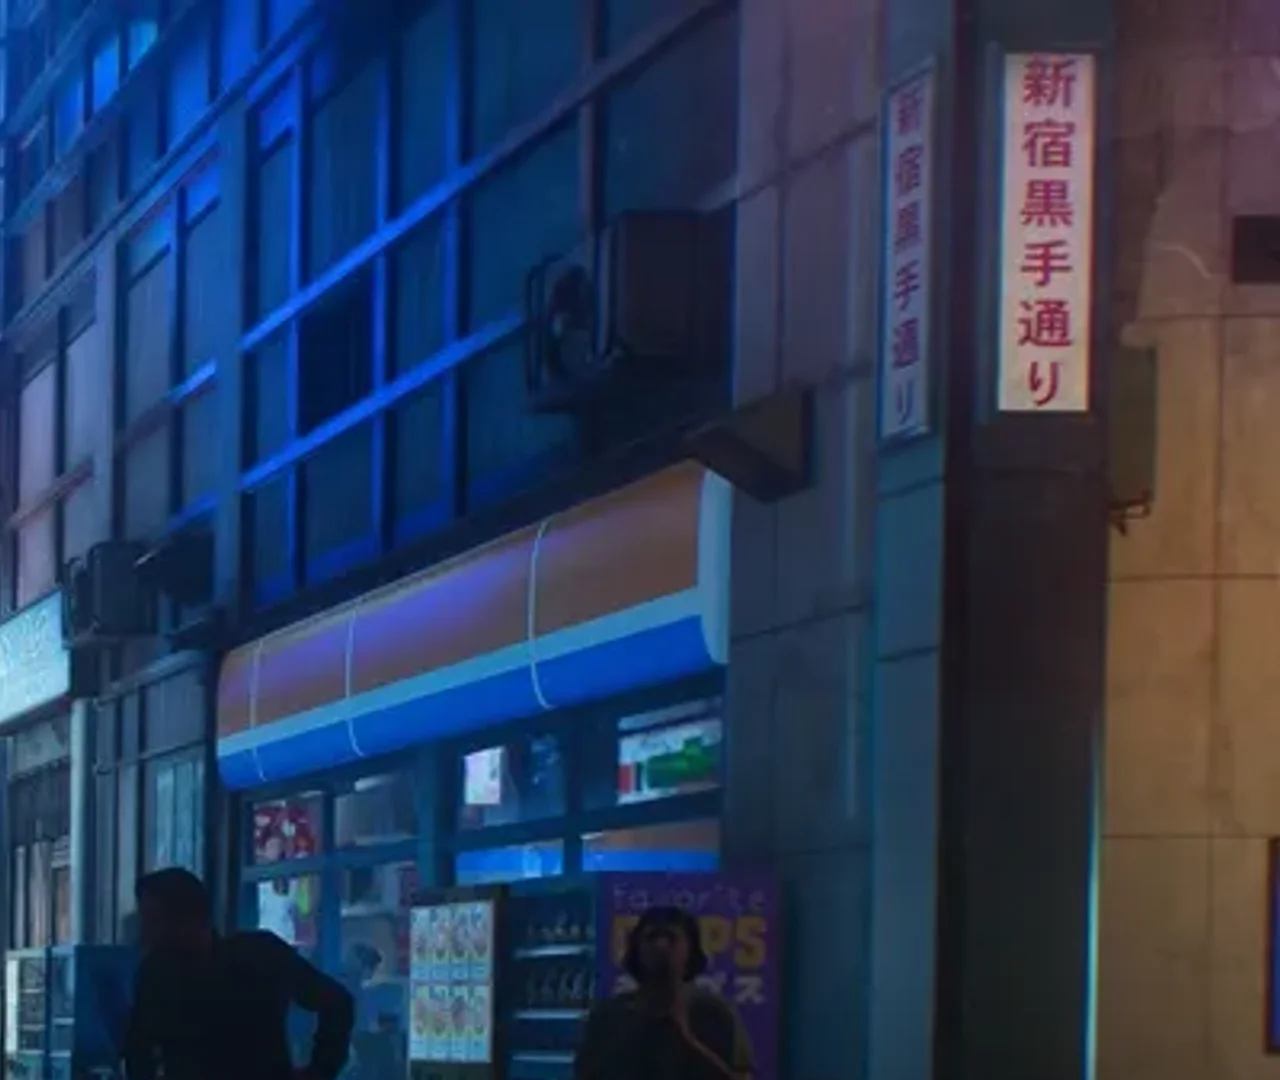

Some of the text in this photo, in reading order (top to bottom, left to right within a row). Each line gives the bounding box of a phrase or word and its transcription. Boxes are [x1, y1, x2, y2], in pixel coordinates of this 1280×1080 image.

[1018, 50, 1077, 406] 新宿黒手通り
